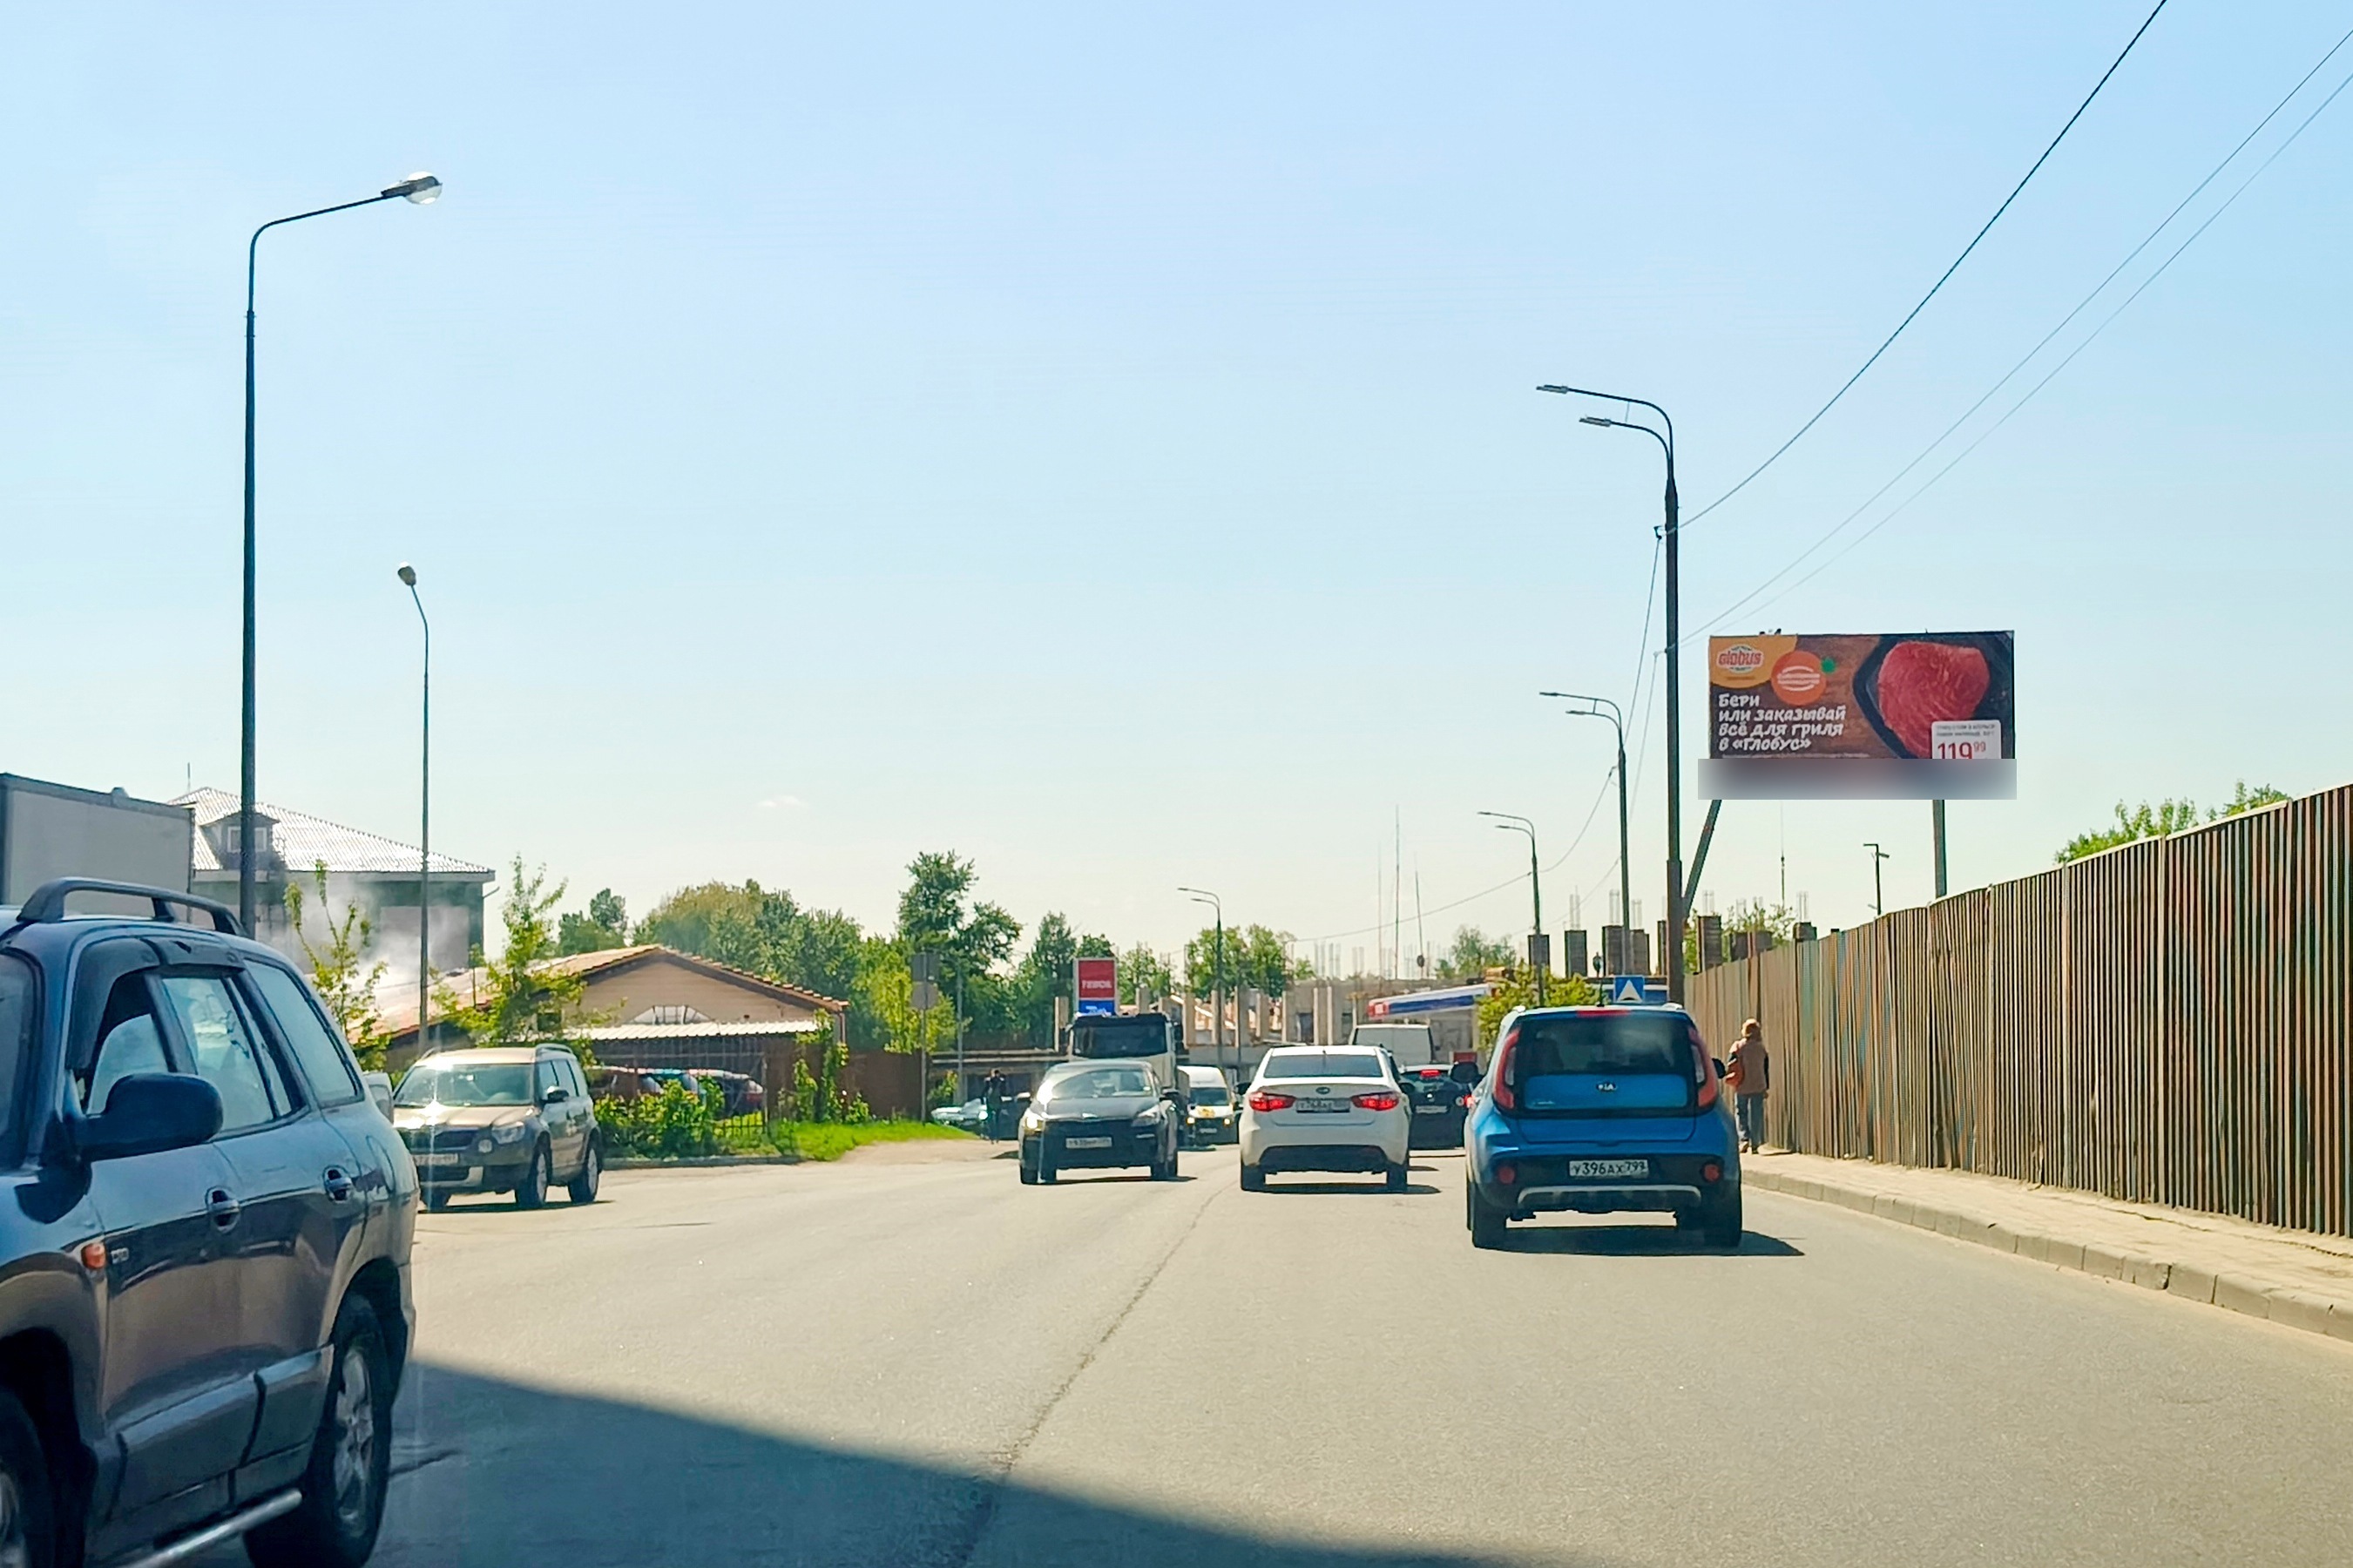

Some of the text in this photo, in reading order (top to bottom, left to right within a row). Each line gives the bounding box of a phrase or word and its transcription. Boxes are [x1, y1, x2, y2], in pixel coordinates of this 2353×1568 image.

[1718, 693, 1760, 707] Бери
[1718, 705, 1846, 722] или заказывай
[1718, 722, 1844, 738] всё для гриля
[1718, 738, 1729, 751] в
